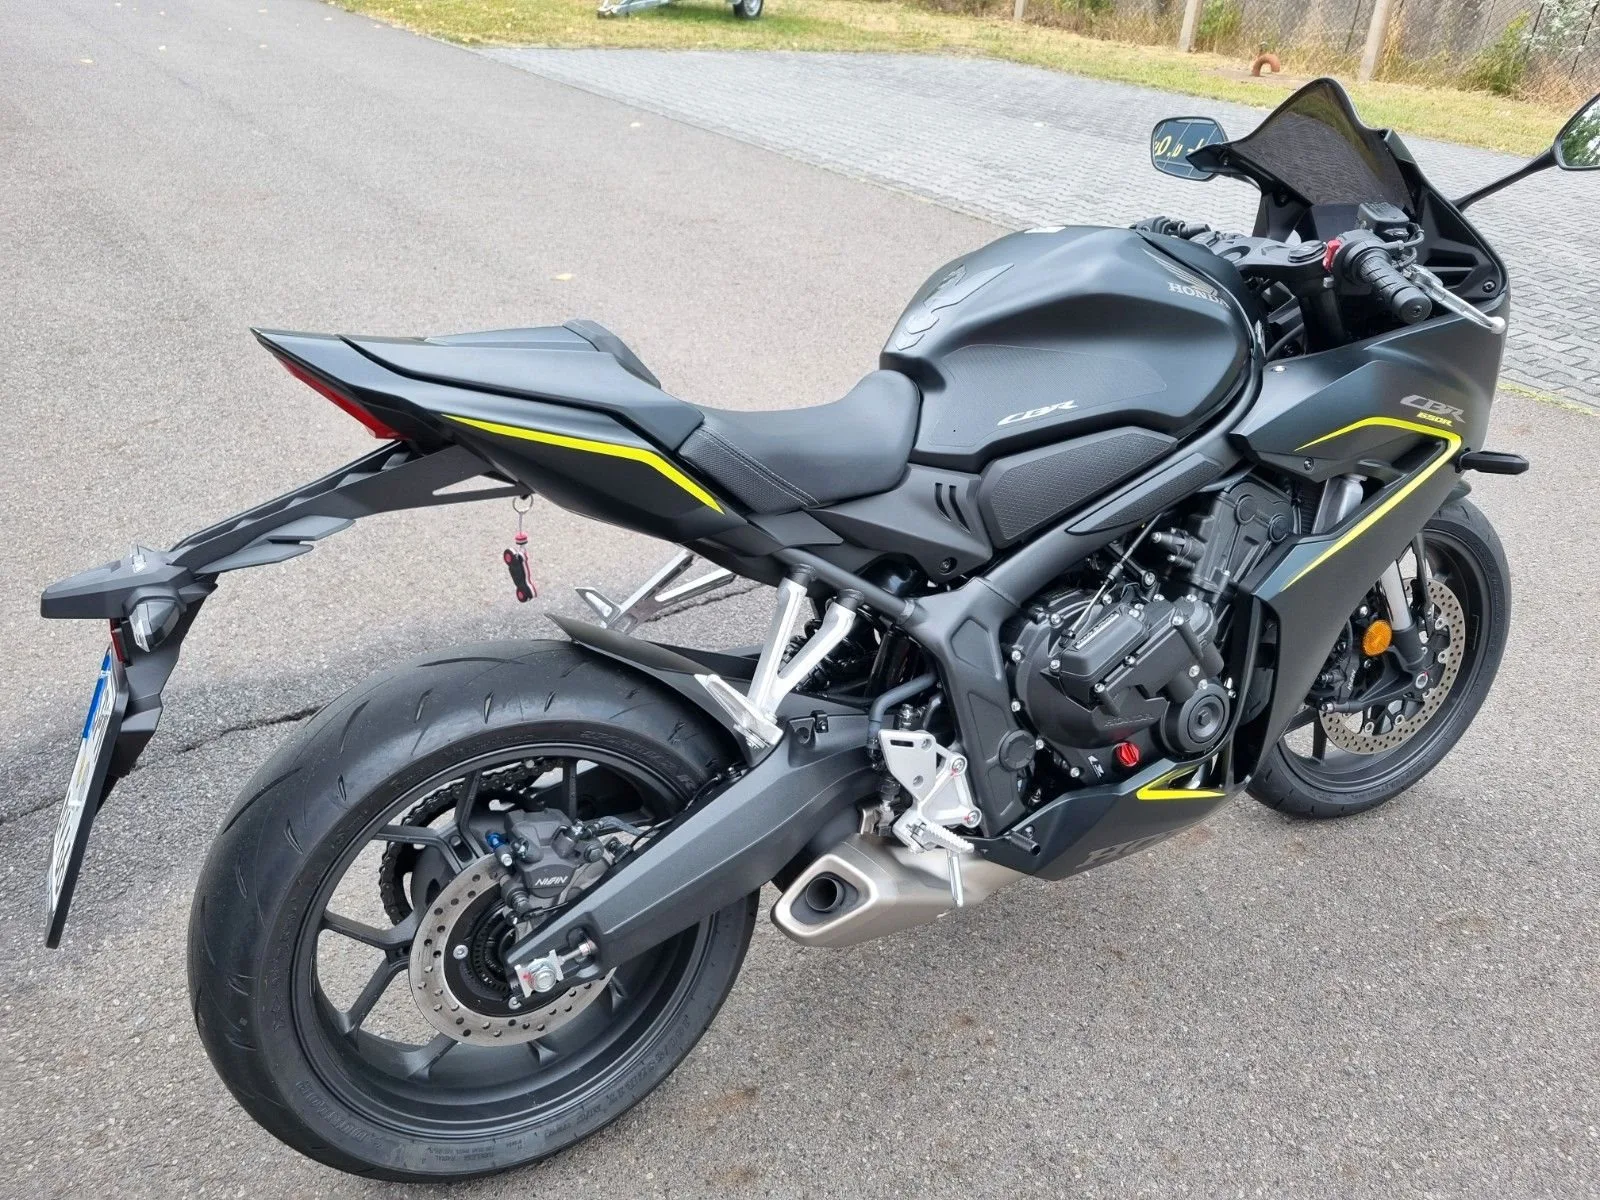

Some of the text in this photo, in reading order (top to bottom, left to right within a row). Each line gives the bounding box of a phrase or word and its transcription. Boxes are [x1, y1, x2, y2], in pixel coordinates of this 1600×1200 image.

[1168, 282, 1231, 310] HONDA
[996, 399, 1079, 426] CBR
[1400, 394, 1466, 424] CBR
[1416, 412, 1453, 427] 650R
[534, 875, 569, 886] NISSIN
